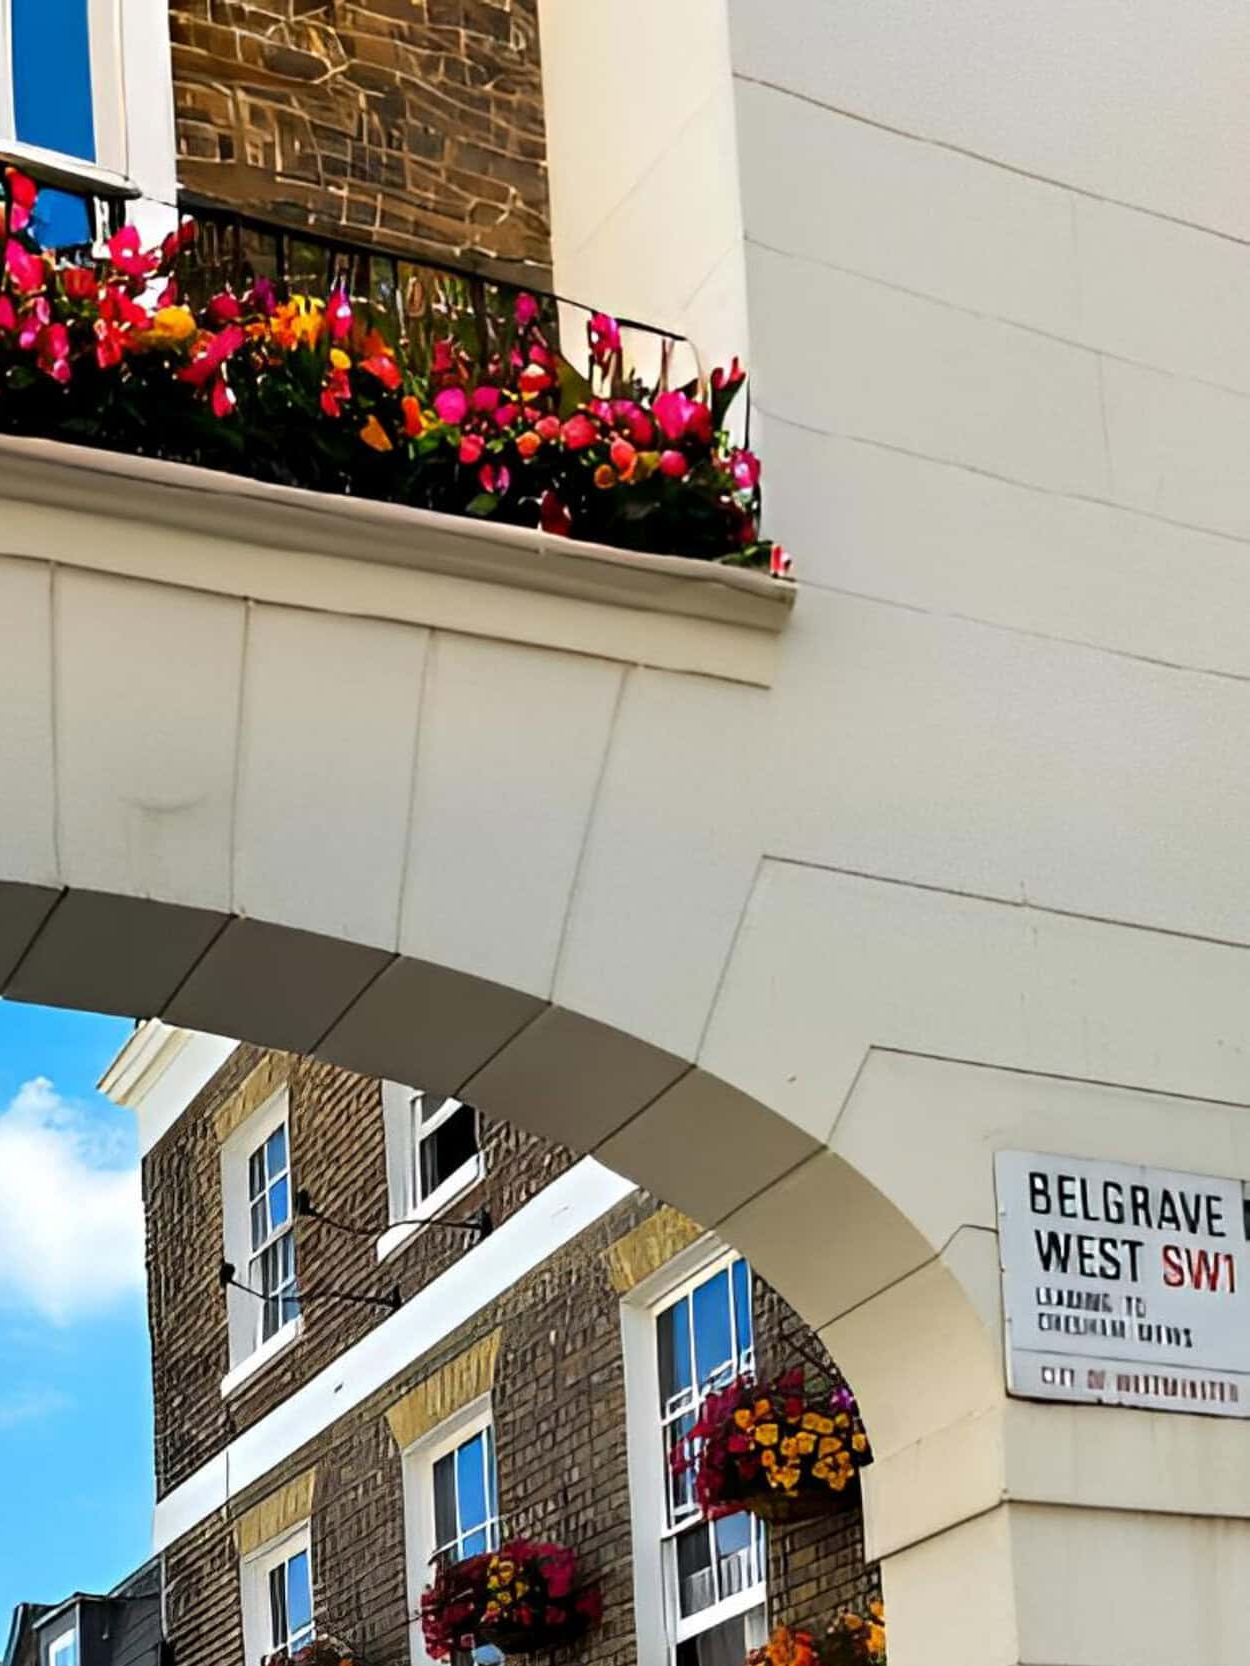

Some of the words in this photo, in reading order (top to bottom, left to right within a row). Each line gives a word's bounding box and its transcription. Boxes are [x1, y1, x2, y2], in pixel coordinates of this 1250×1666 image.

[1028, 1171, 1227, 1238] BELGRAVE
[1034, 1229, 1144, 1283] WEST
[1161, 1244, 1236, 1294] SW1
